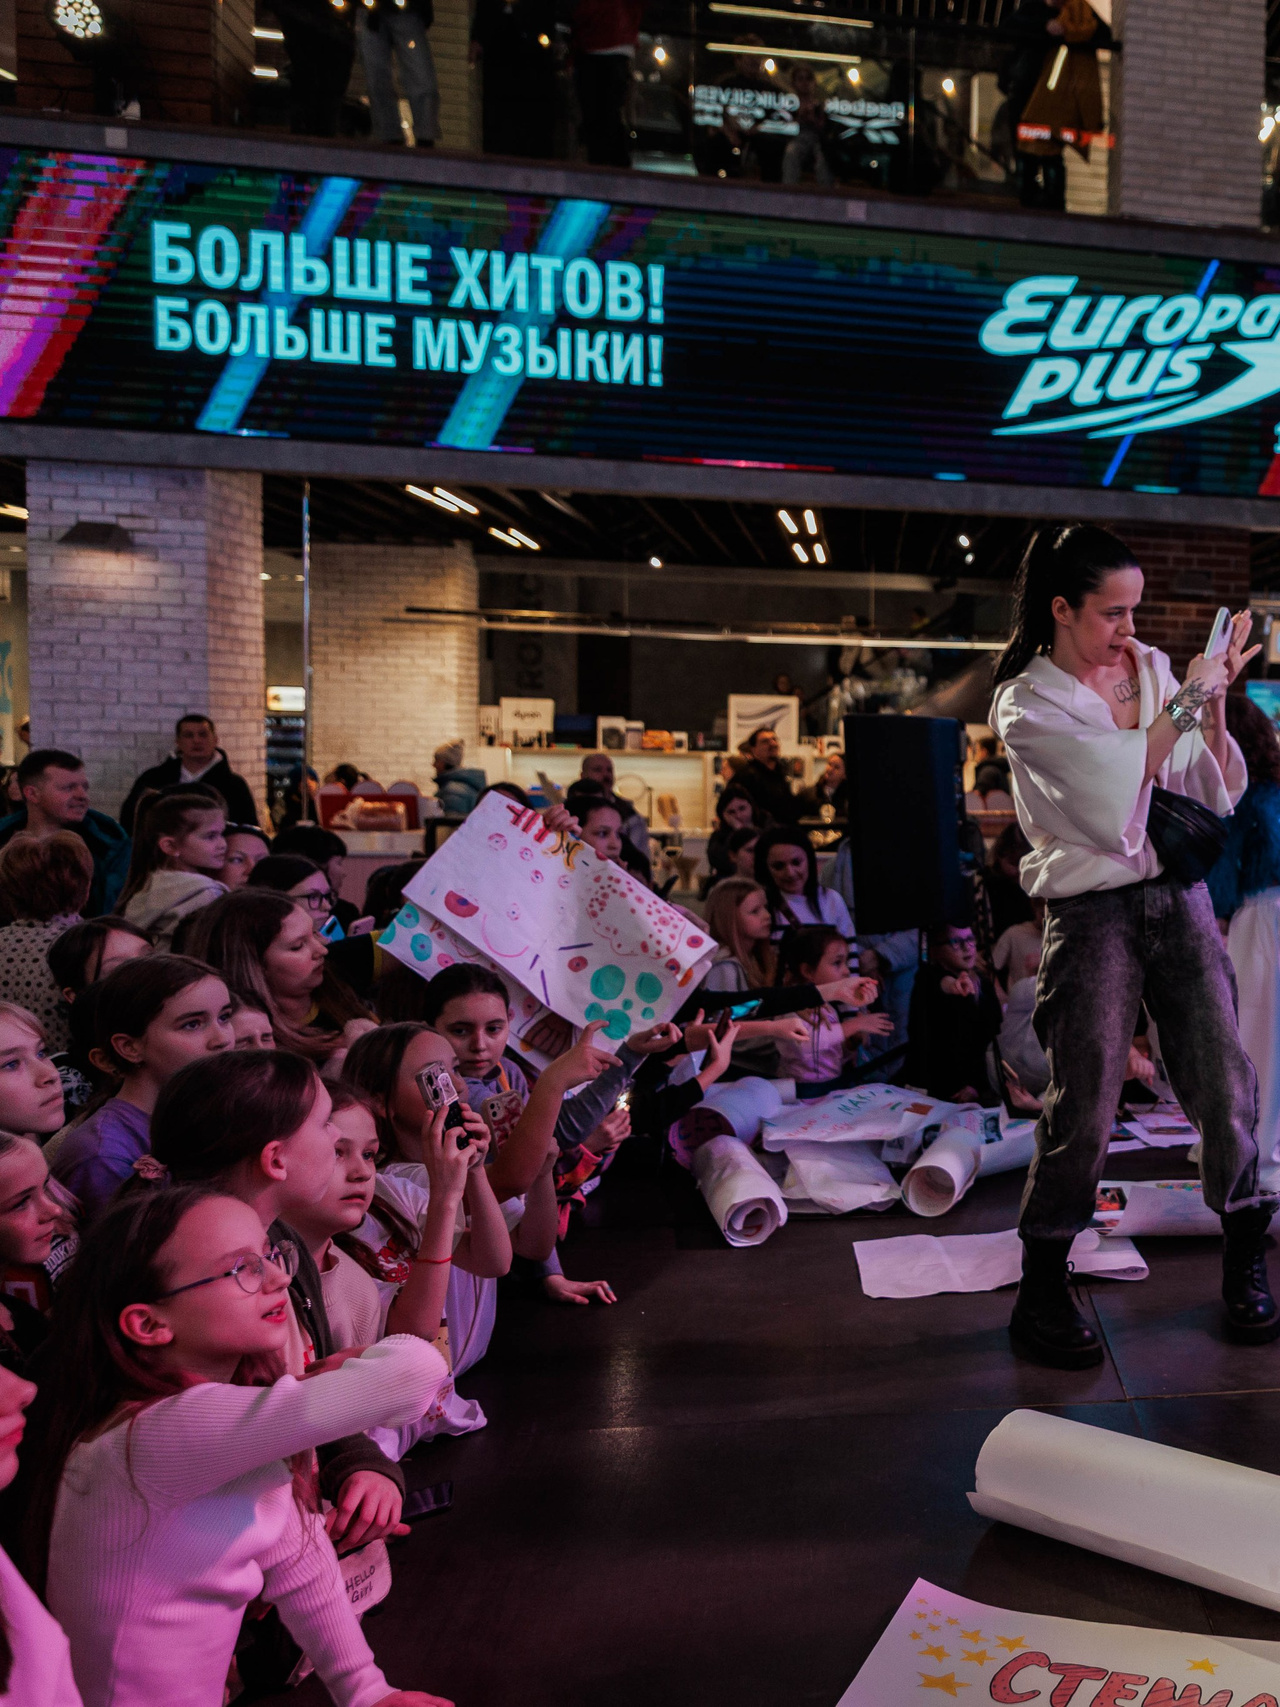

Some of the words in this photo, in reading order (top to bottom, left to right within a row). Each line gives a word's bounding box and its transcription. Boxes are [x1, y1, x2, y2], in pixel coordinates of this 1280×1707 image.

[151, 220, 433, 306] БОЛЬШЕ
[447, 247, 666, 324] ХИТОВ!
[153, 295, 397, 367] БОЛЬШЕ
[411, 316, 665, 387] МУЗЫКИ!
[344, 1564, 376, 1594] HELLO
[989, 1651, 1280, 1707] СТЕШ
